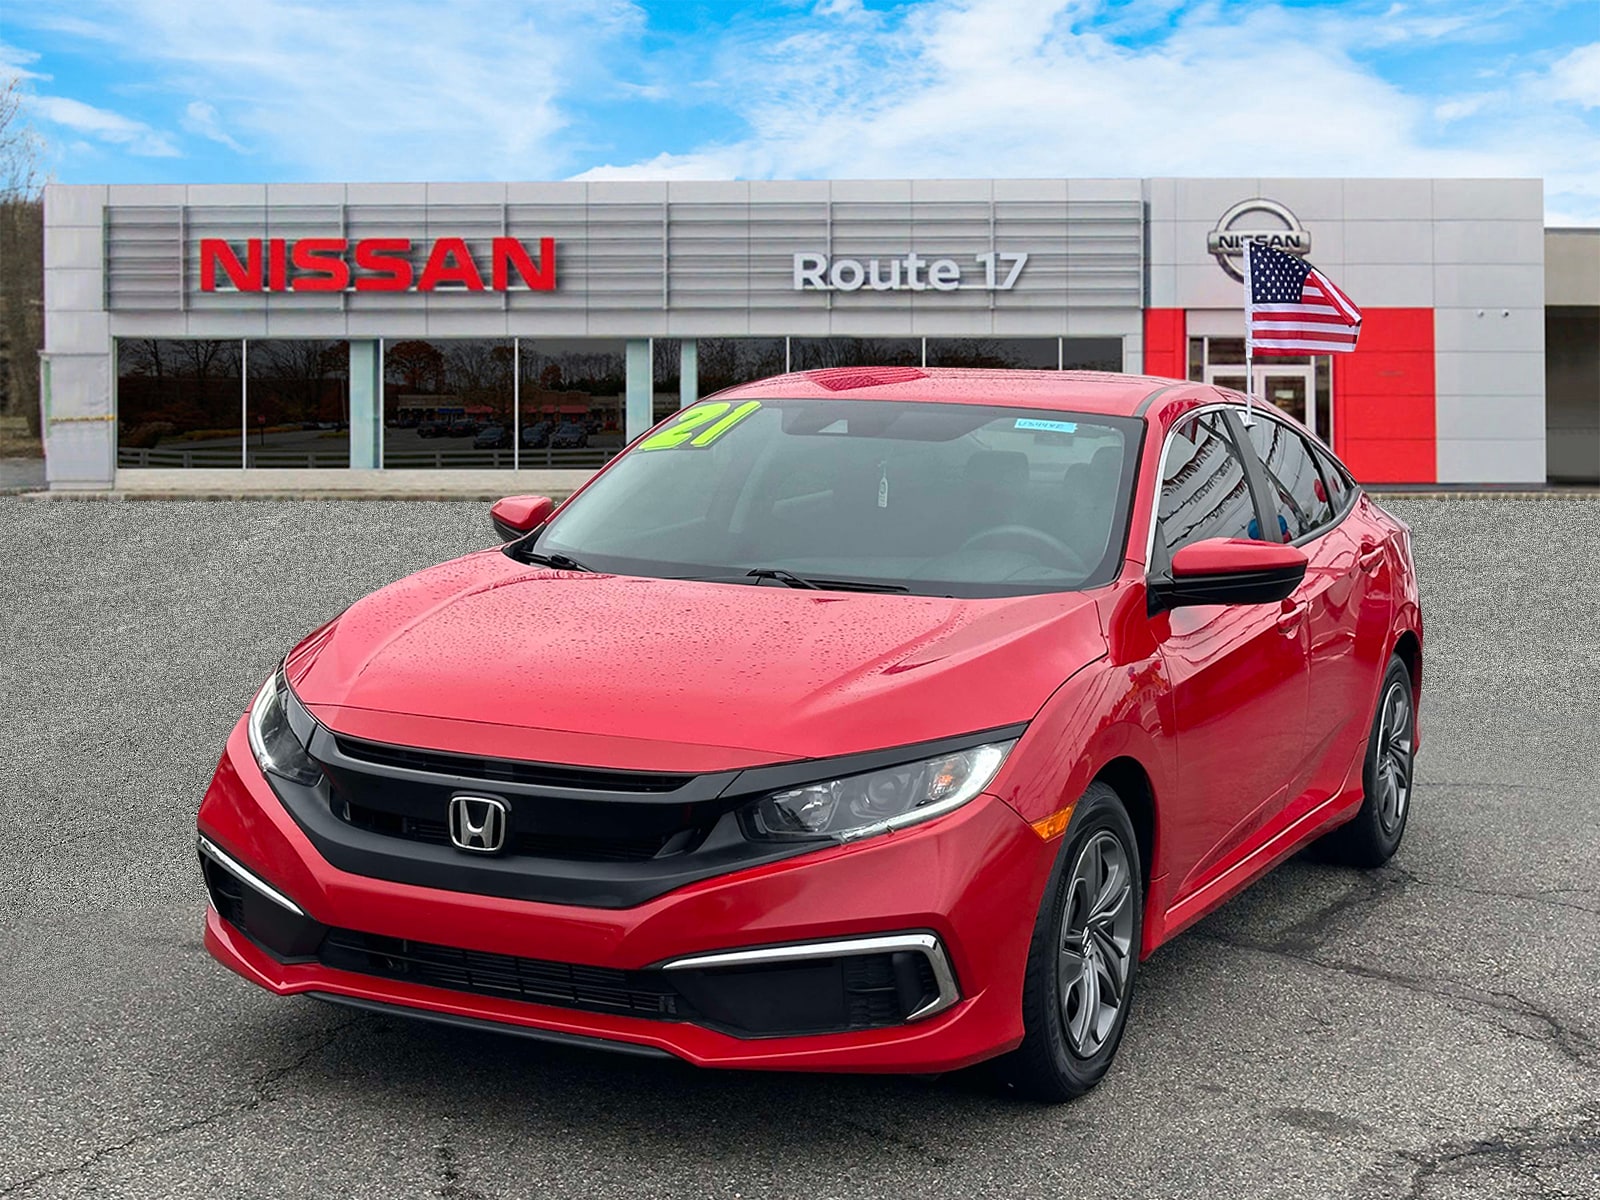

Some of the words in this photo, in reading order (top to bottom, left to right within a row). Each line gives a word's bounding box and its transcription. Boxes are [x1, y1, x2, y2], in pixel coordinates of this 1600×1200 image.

[200, 237, 555, 292] NISSAN
[793, 252, 960, 291] Route
[976, 252, 1028, 290] 17
[638, 400, 762, 451] 21
